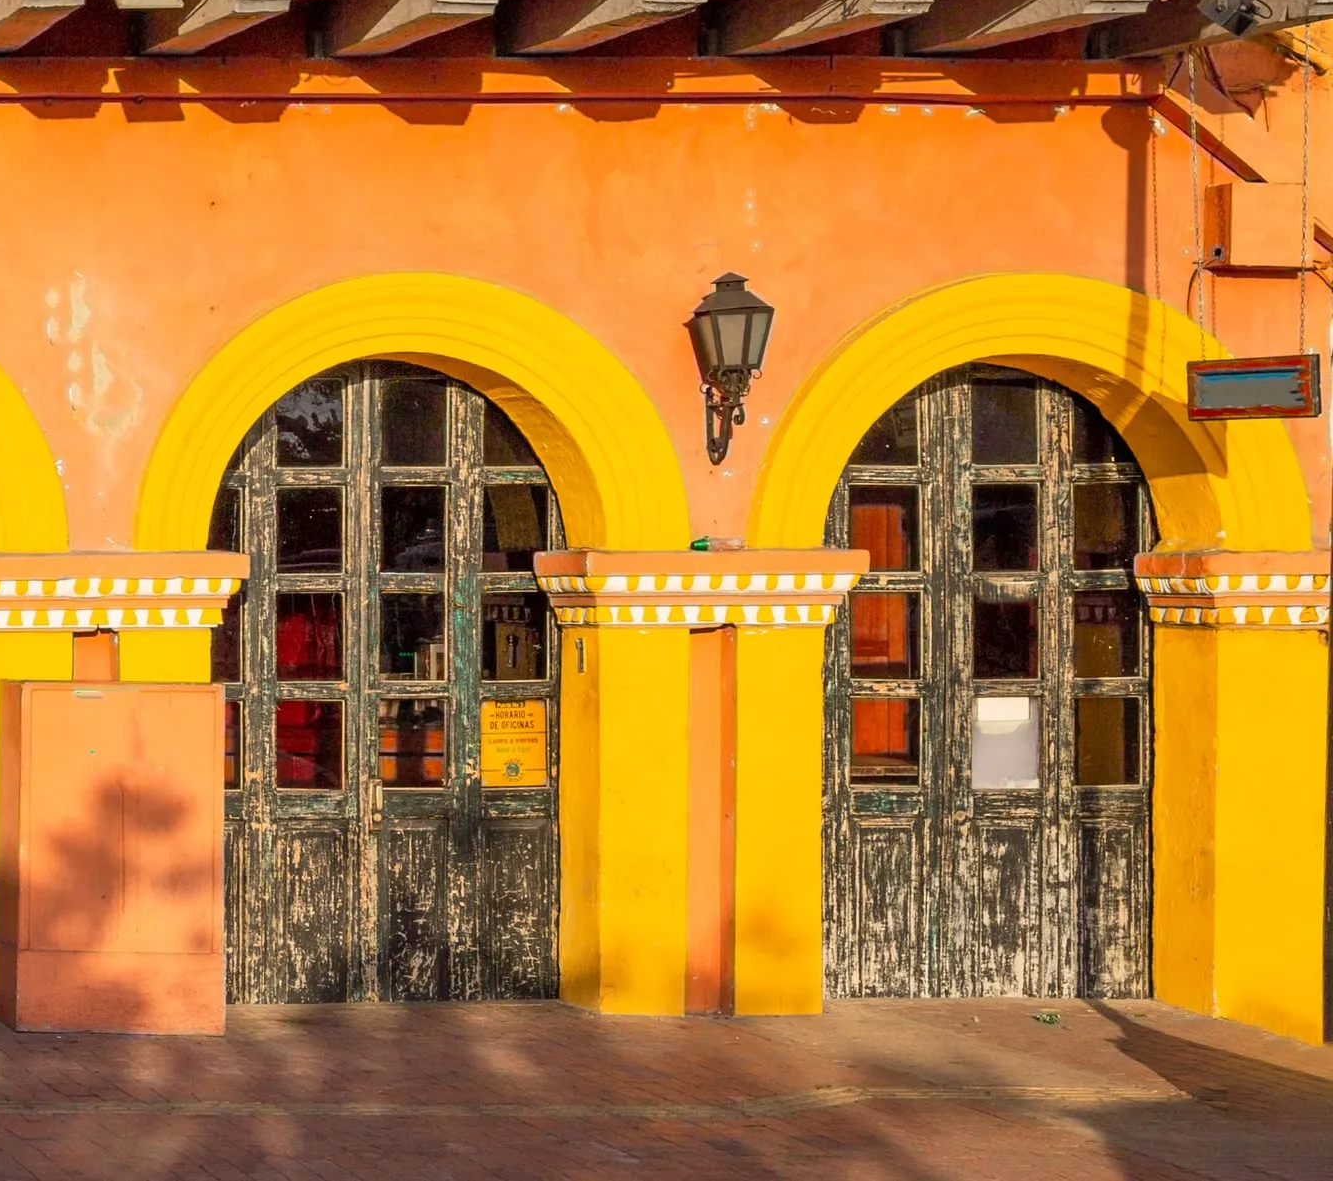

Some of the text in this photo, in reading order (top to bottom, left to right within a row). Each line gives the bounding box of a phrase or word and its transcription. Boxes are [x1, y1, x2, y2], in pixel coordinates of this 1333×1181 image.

[495, 710, 526, 719] HORARIO
[490, 720, 535, 730] DE OFICINAS
